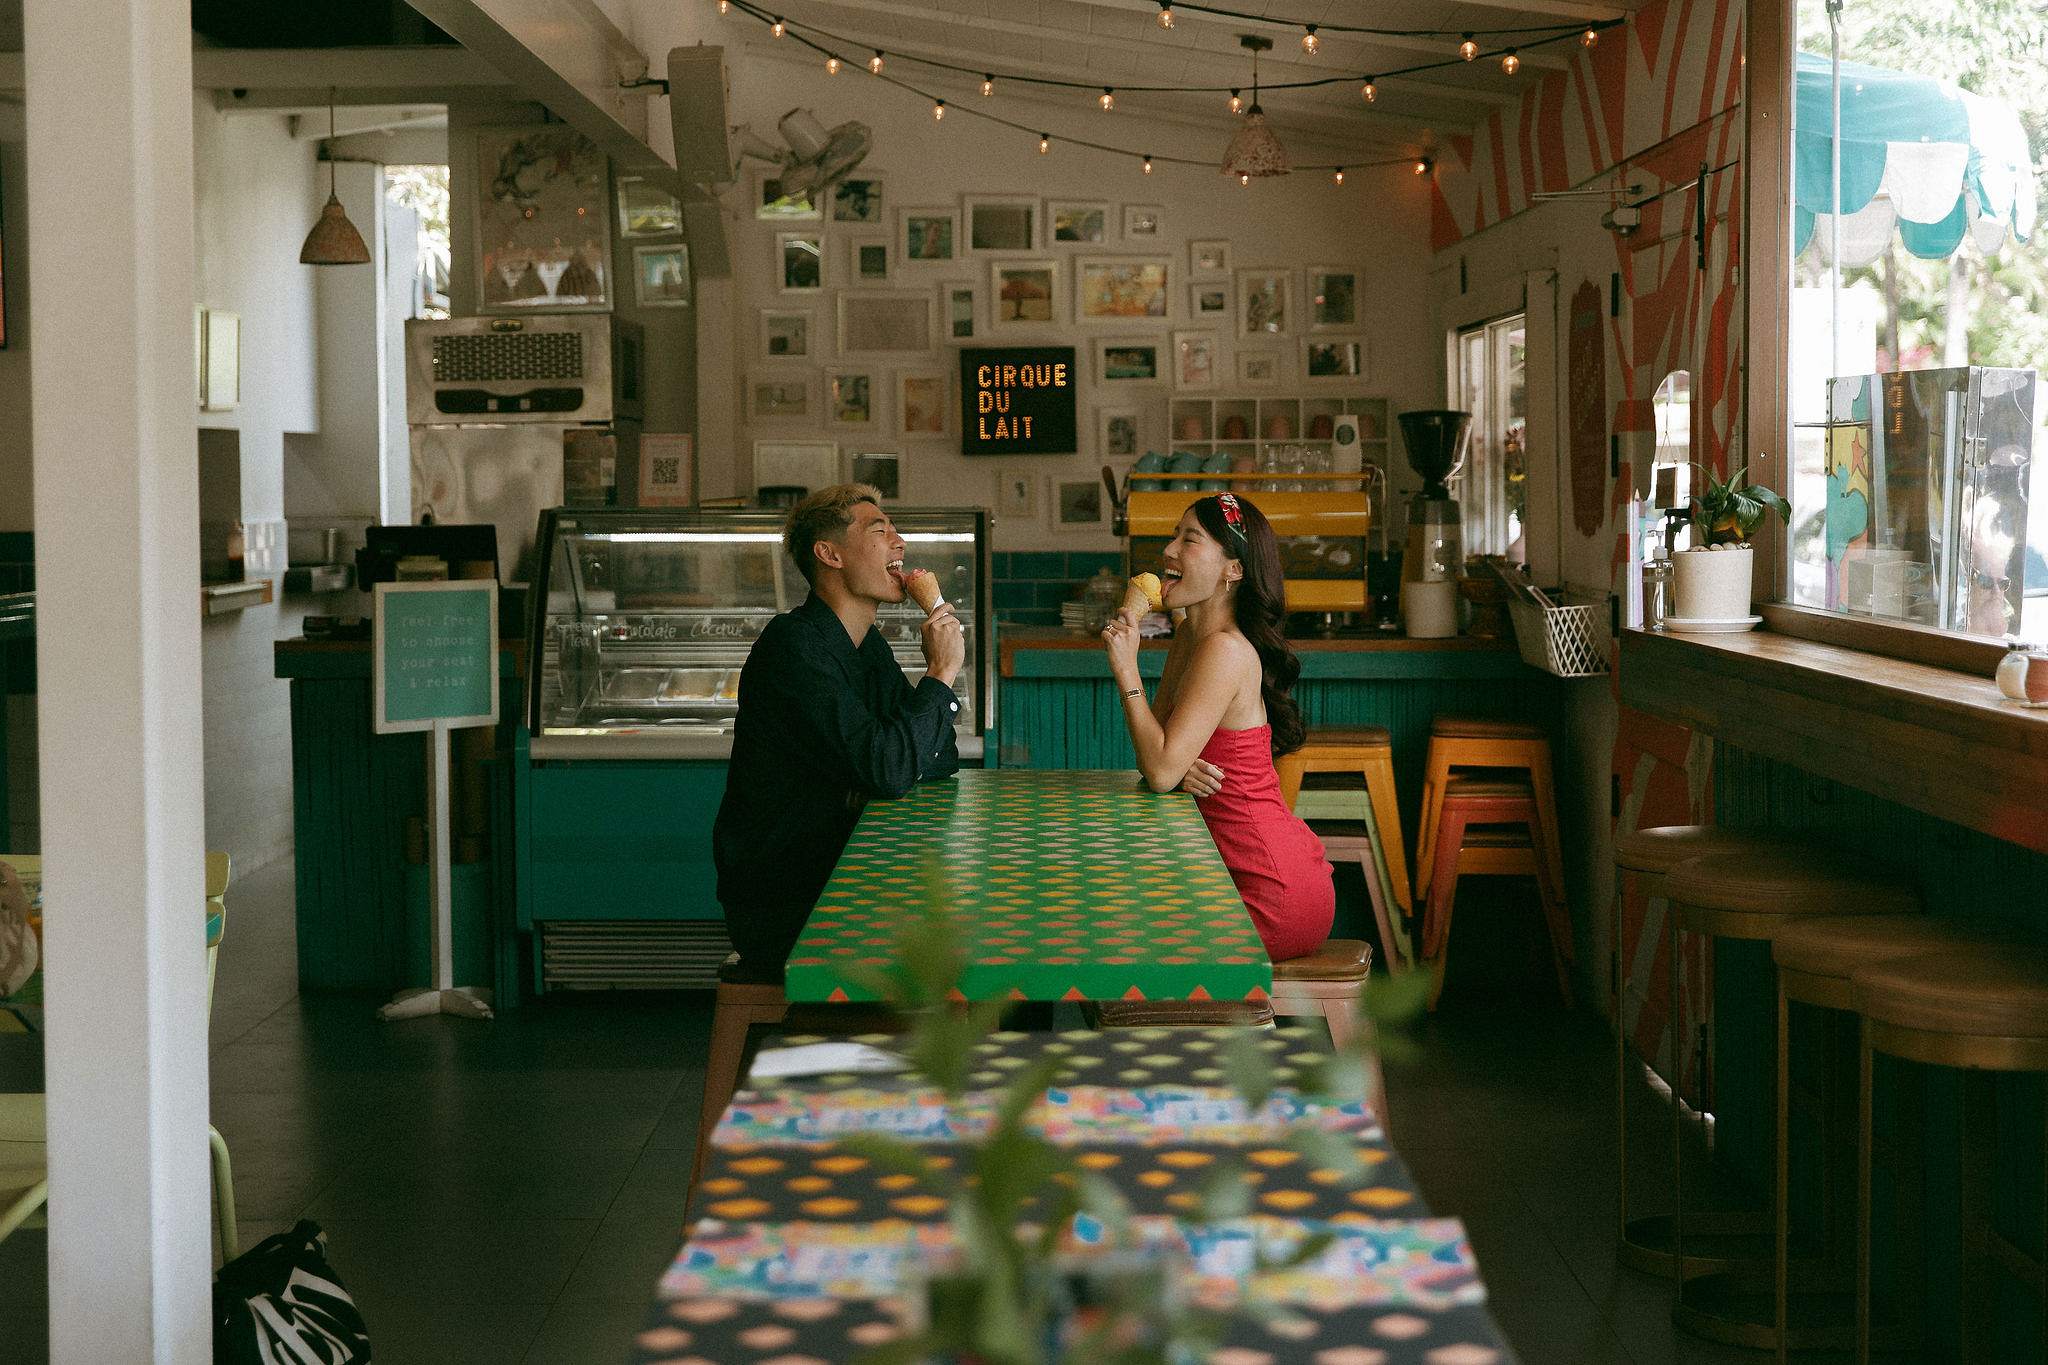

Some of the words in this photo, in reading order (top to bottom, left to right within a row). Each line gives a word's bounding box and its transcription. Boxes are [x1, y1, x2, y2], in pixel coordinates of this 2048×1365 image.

[978, 364, 1066, 389] CIRQUE
[979, 391, 1010, 413] DU
[979, 416, 1033, 440] LAIT
[611, 619, 677, 640] hocolate
